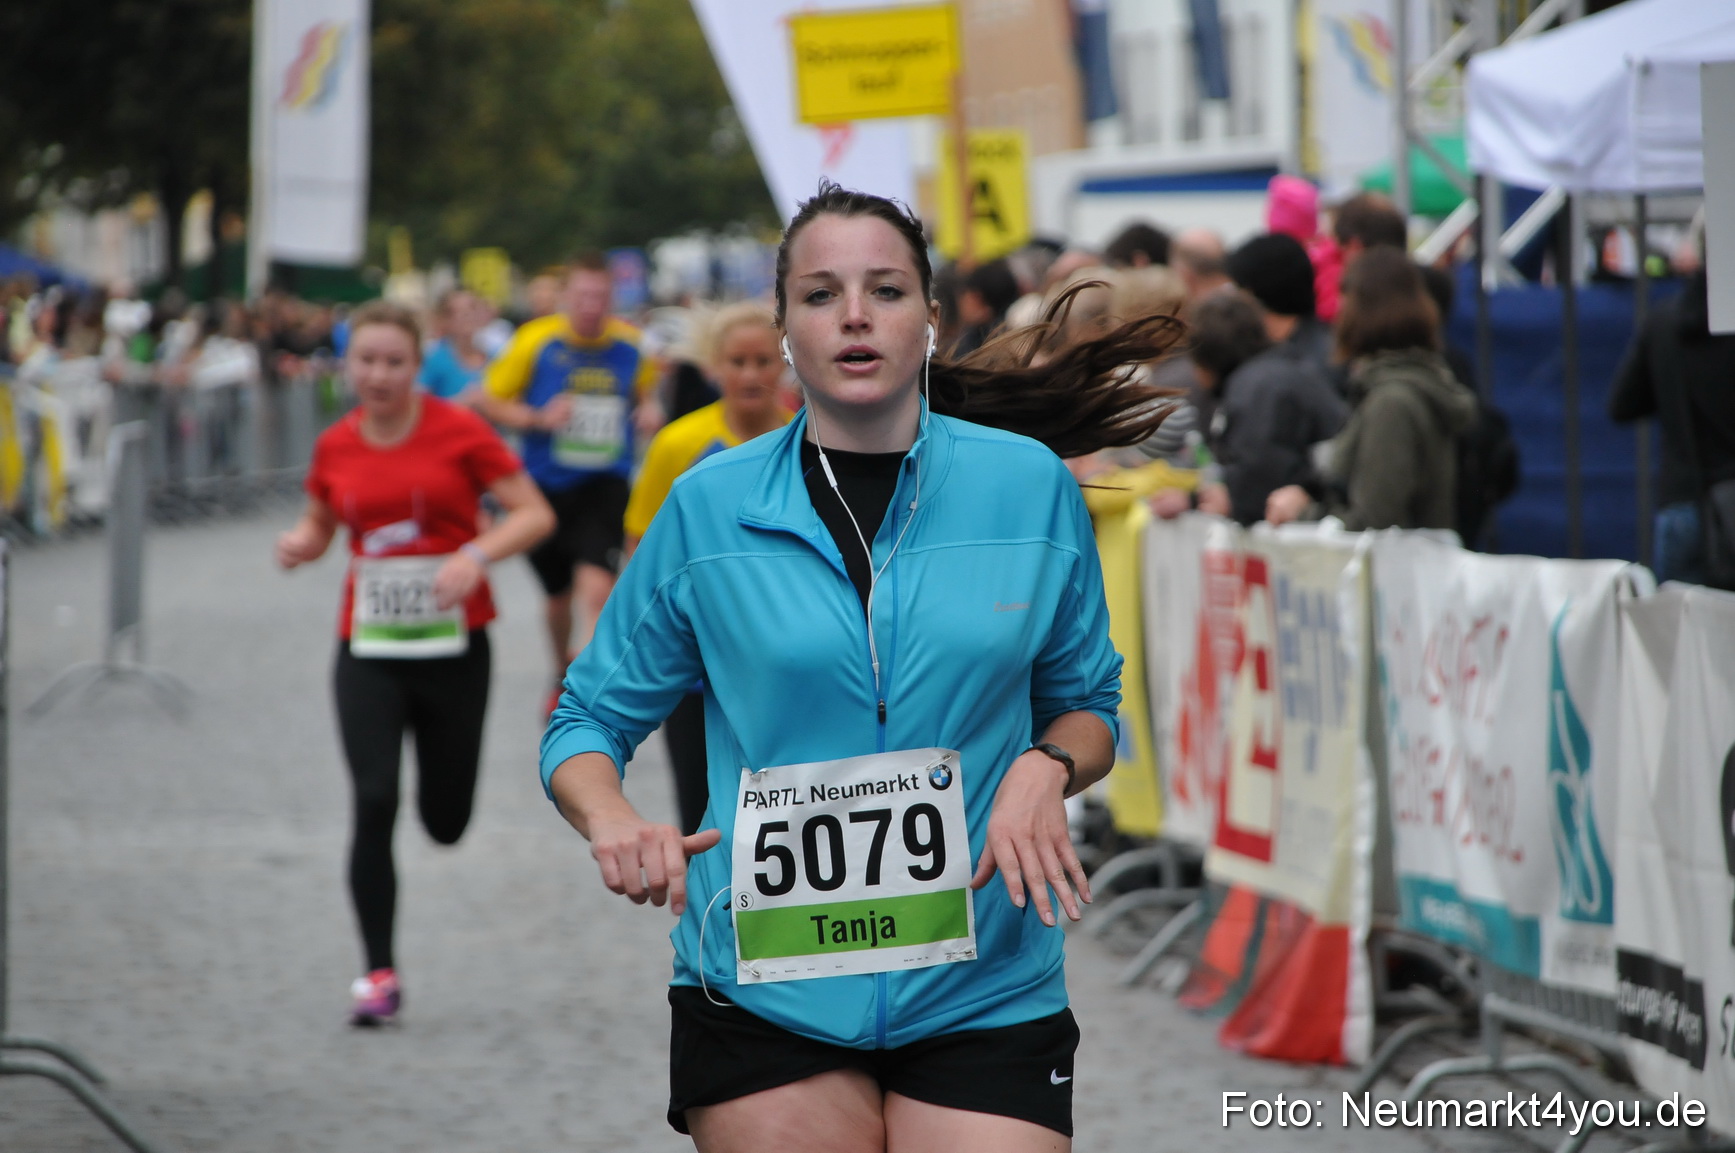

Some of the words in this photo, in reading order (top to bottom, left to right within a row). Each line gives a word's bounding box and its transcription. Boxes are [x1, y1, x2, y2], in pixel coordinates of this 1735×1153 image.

[743, 787, 805, 810] PARTL
[810, 773, 920, 803] Neumarkt
[754, 802, 947, 897] 5079
[740, 894, 749, 908] S
[810, 910, 897, 947] Tanja
